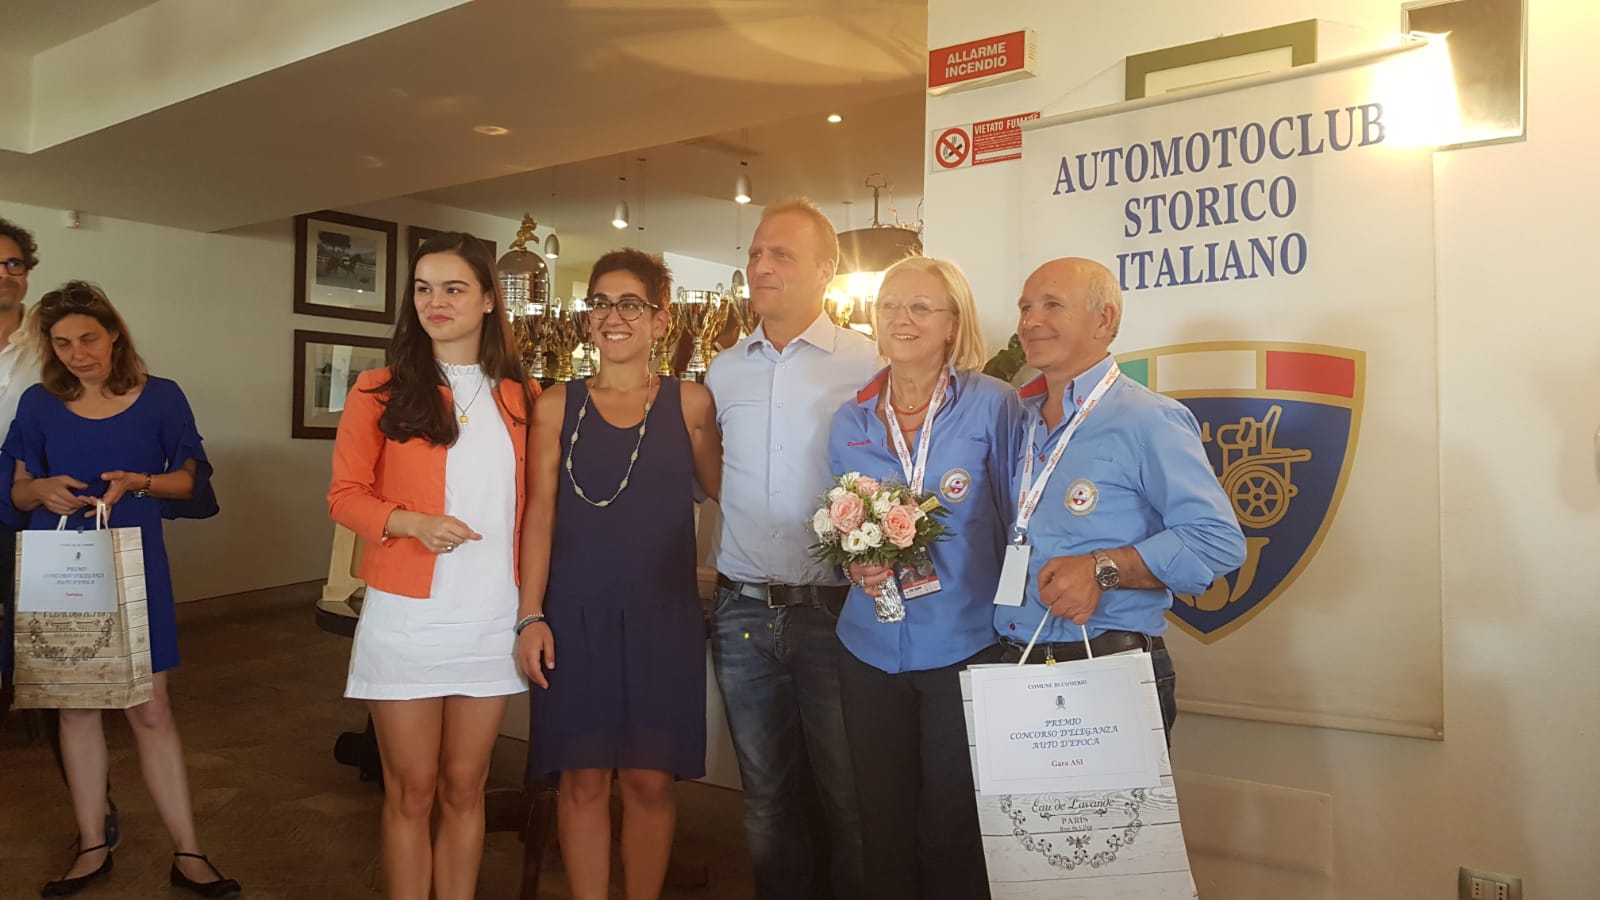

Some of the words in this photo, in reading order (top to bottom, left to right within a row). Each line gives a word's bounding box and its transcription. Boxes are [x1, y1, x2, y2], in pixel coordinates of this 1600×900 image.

[947, 42, 1006, 64] ALLARME
[945, 55, 1007, 78] INCENDIO
[974, 121, 1004, 135] VIETATO
[1052, 102, 1386, 195] AUTOMOTOCLUB
[1124, 175, 1297, 238] STORICO
[1116, 232, 1307, 291] ITALIANO
[1044, 717, 1082, 728] PREMIO
[1010, 730, 1058, 740] CONCORSO
[1060, 725, 1119, 737] D'ELEGANZA
[1032, 741, 1058, 750] AUTO
[1060, 737, 1100, 748] D'EPOCA
[1051, 760, 1069, 768] Gara
[1032, 800, 1052, 813] Eau
[1054, 799, 1066, 811] de
[1068, 795, 1114, 810] Lavande
[1061, 817, 1089, 825] PARIS
